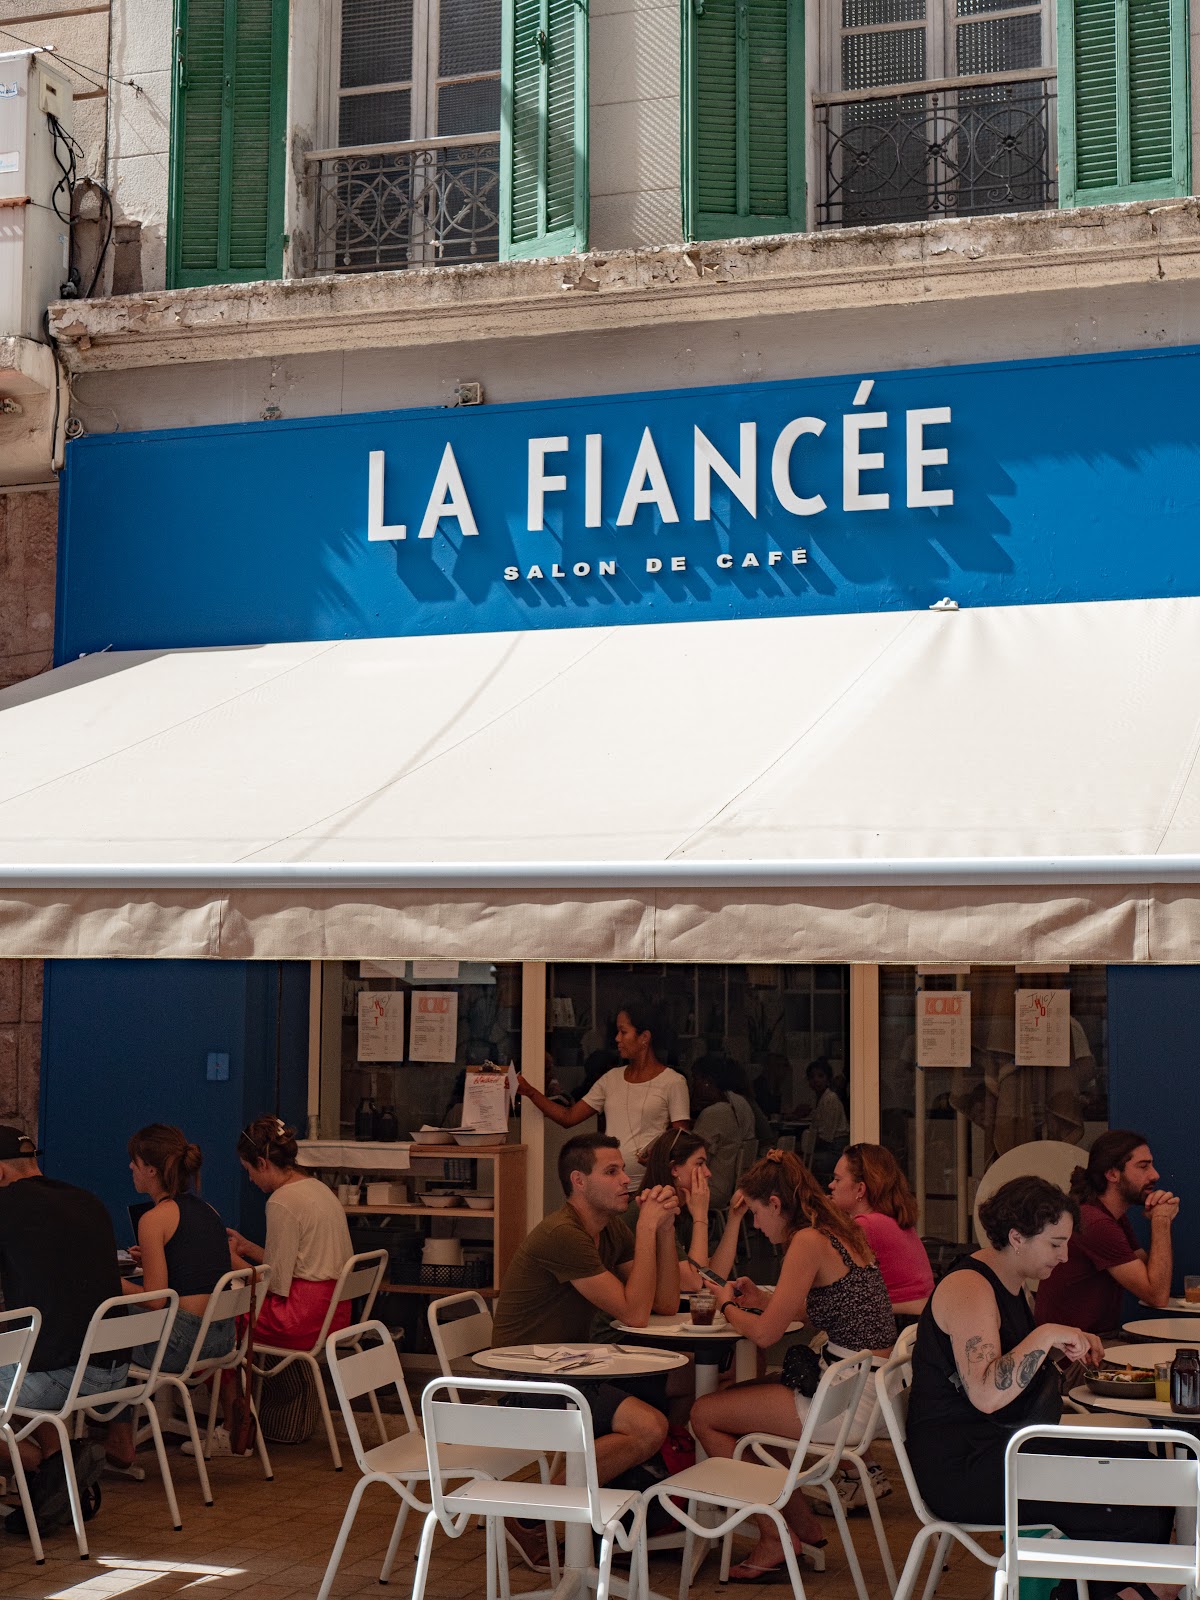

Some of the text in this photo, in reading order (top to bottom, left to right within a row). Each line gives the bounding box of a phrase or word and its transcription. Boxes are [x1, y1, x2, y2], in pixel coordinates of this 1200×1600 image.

[367, 379, 955, 542] LA FIANCÉE
[503, 547, 809, 582] SALON DE CAFÉ
